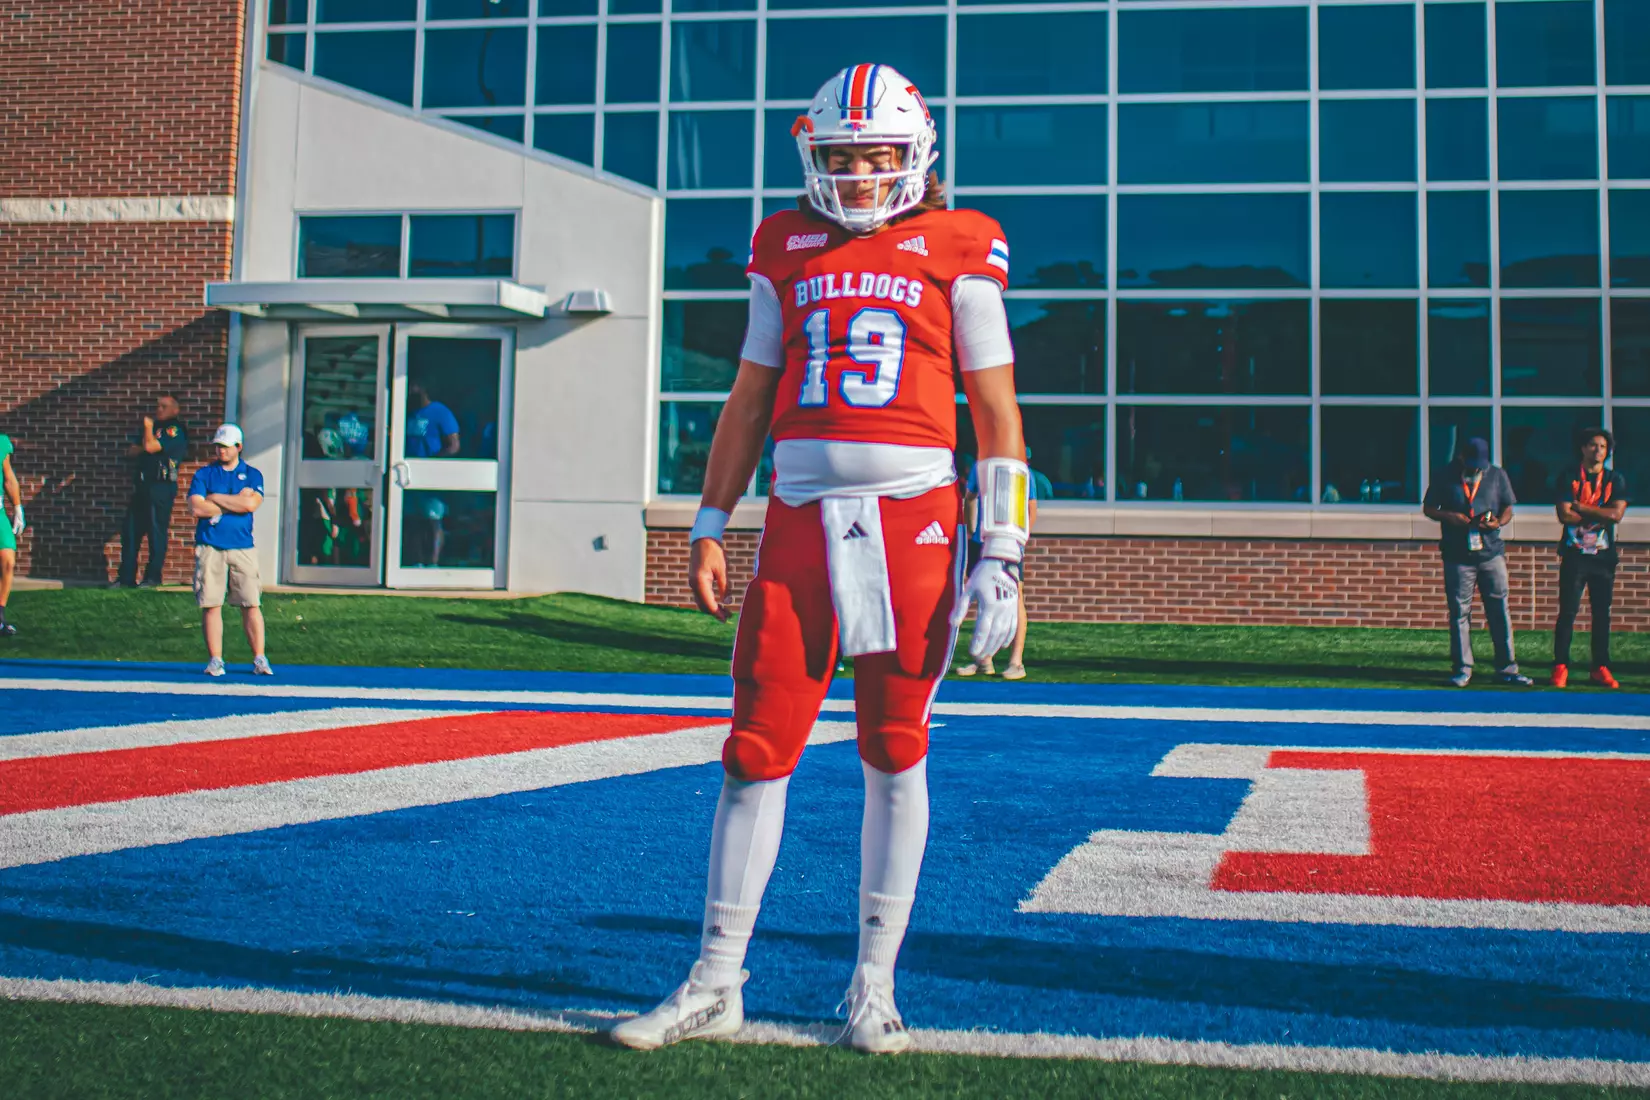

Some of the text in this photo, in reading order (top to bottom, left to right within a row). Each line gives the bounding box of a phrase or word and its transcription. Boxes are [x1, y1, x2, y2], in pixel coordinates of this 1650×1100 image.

[795, 272, 923, 308] BULLDOGS
[797, 306, 908, 409] 19
[915, 535, 949, 545] adidas
